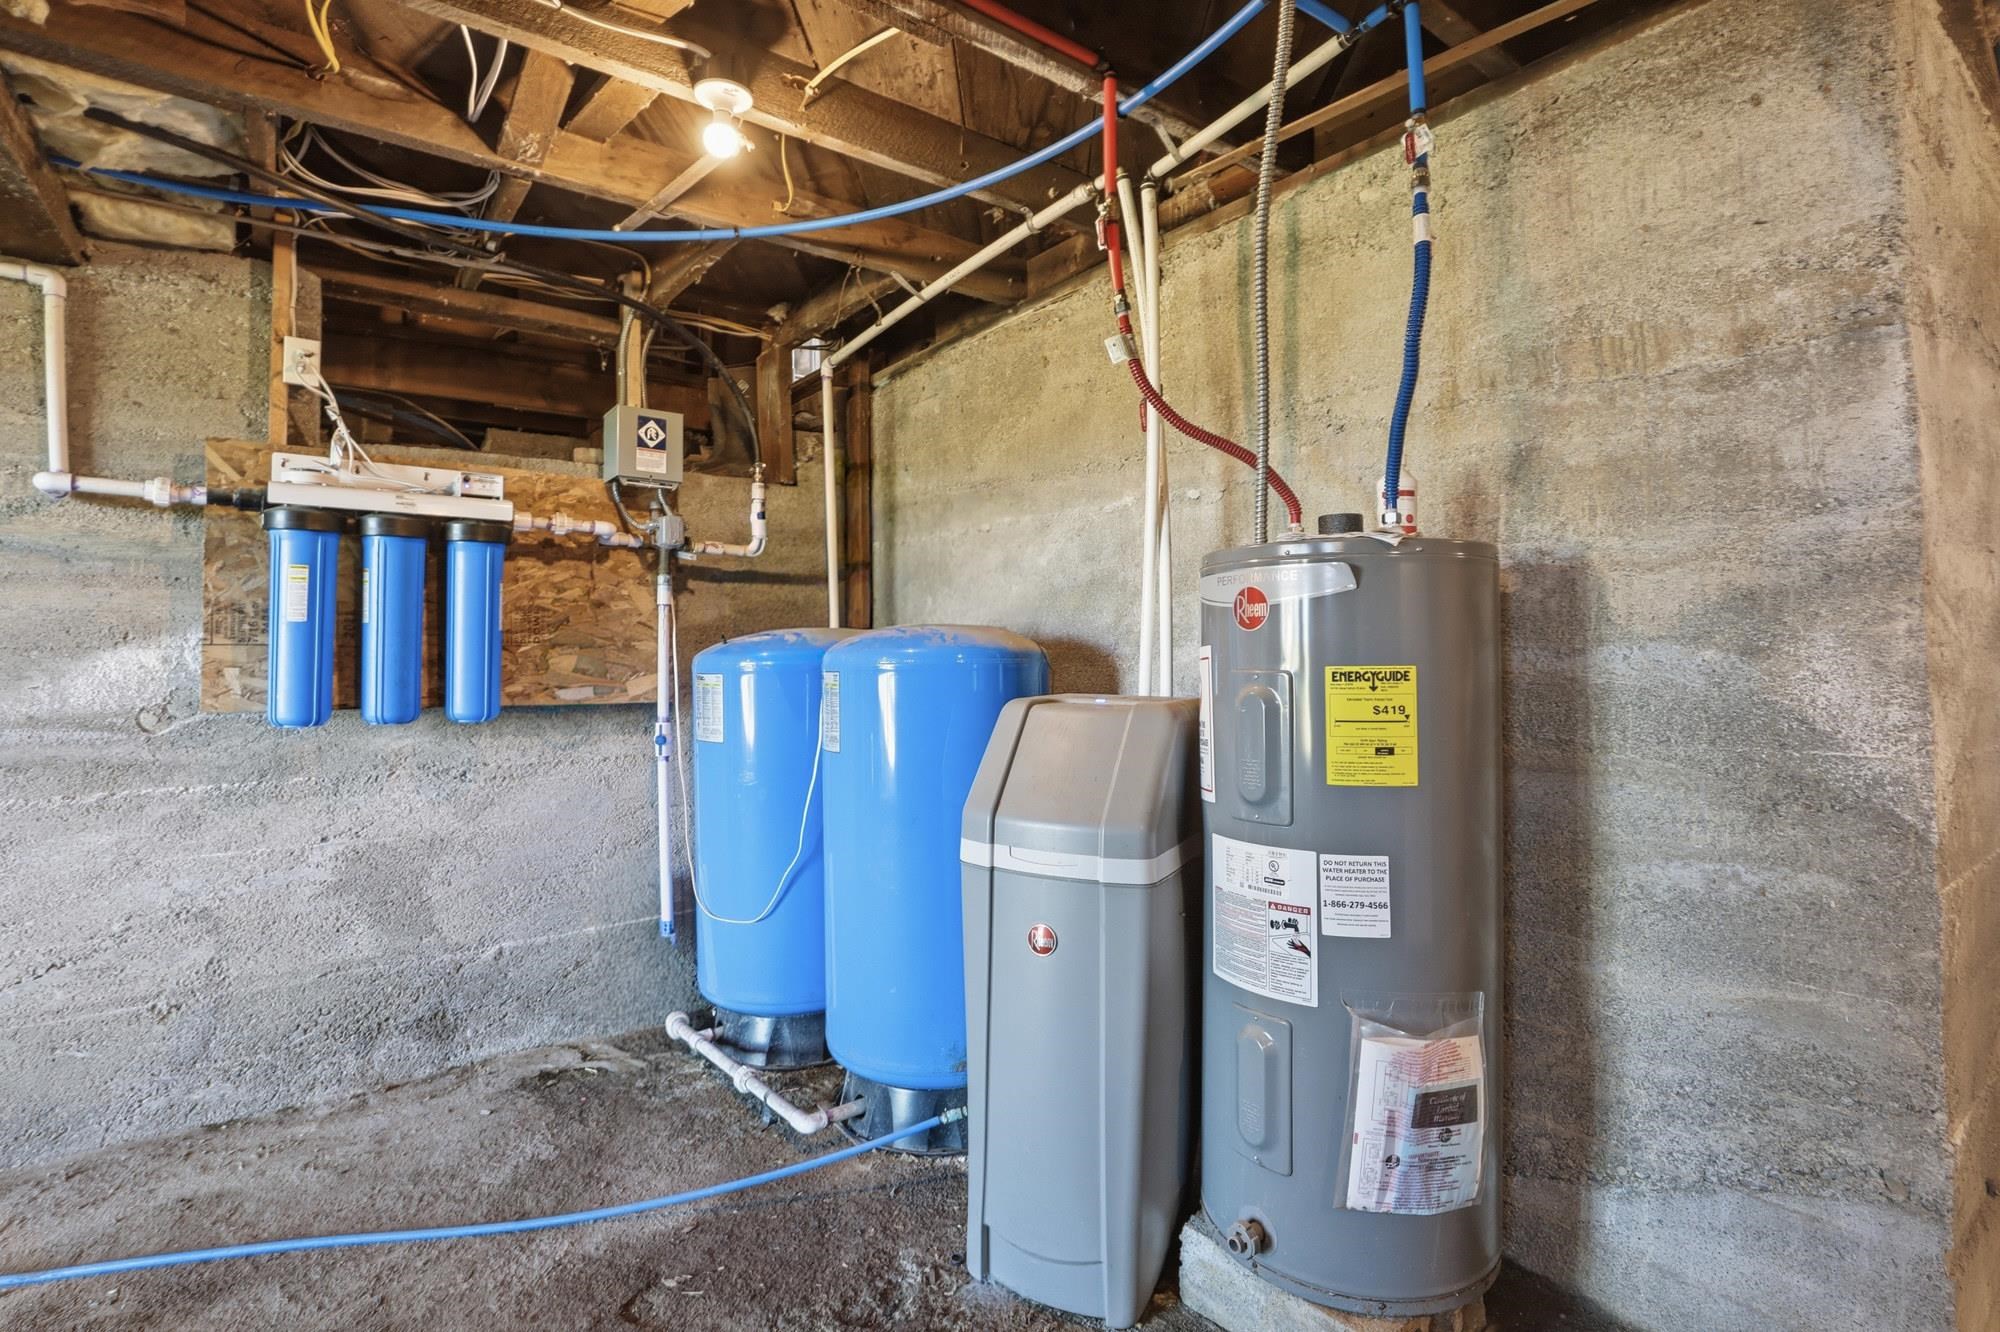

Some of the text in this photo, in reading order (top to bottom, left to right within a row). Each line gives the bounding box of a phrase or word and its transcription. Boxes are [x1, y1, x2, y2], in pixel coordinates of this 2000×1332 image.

[1236, 587, 1267, 624] Rheem
[1331, 670, 1411, 682] ENERGYGUIDE
[1373, 705, 1406, 715] $419
[1277, 903, 1309, 914] DANGER
[1323, 899, 1389, 909] 1-866-279-4566
[1031, 927, 1054, 951] Rem
